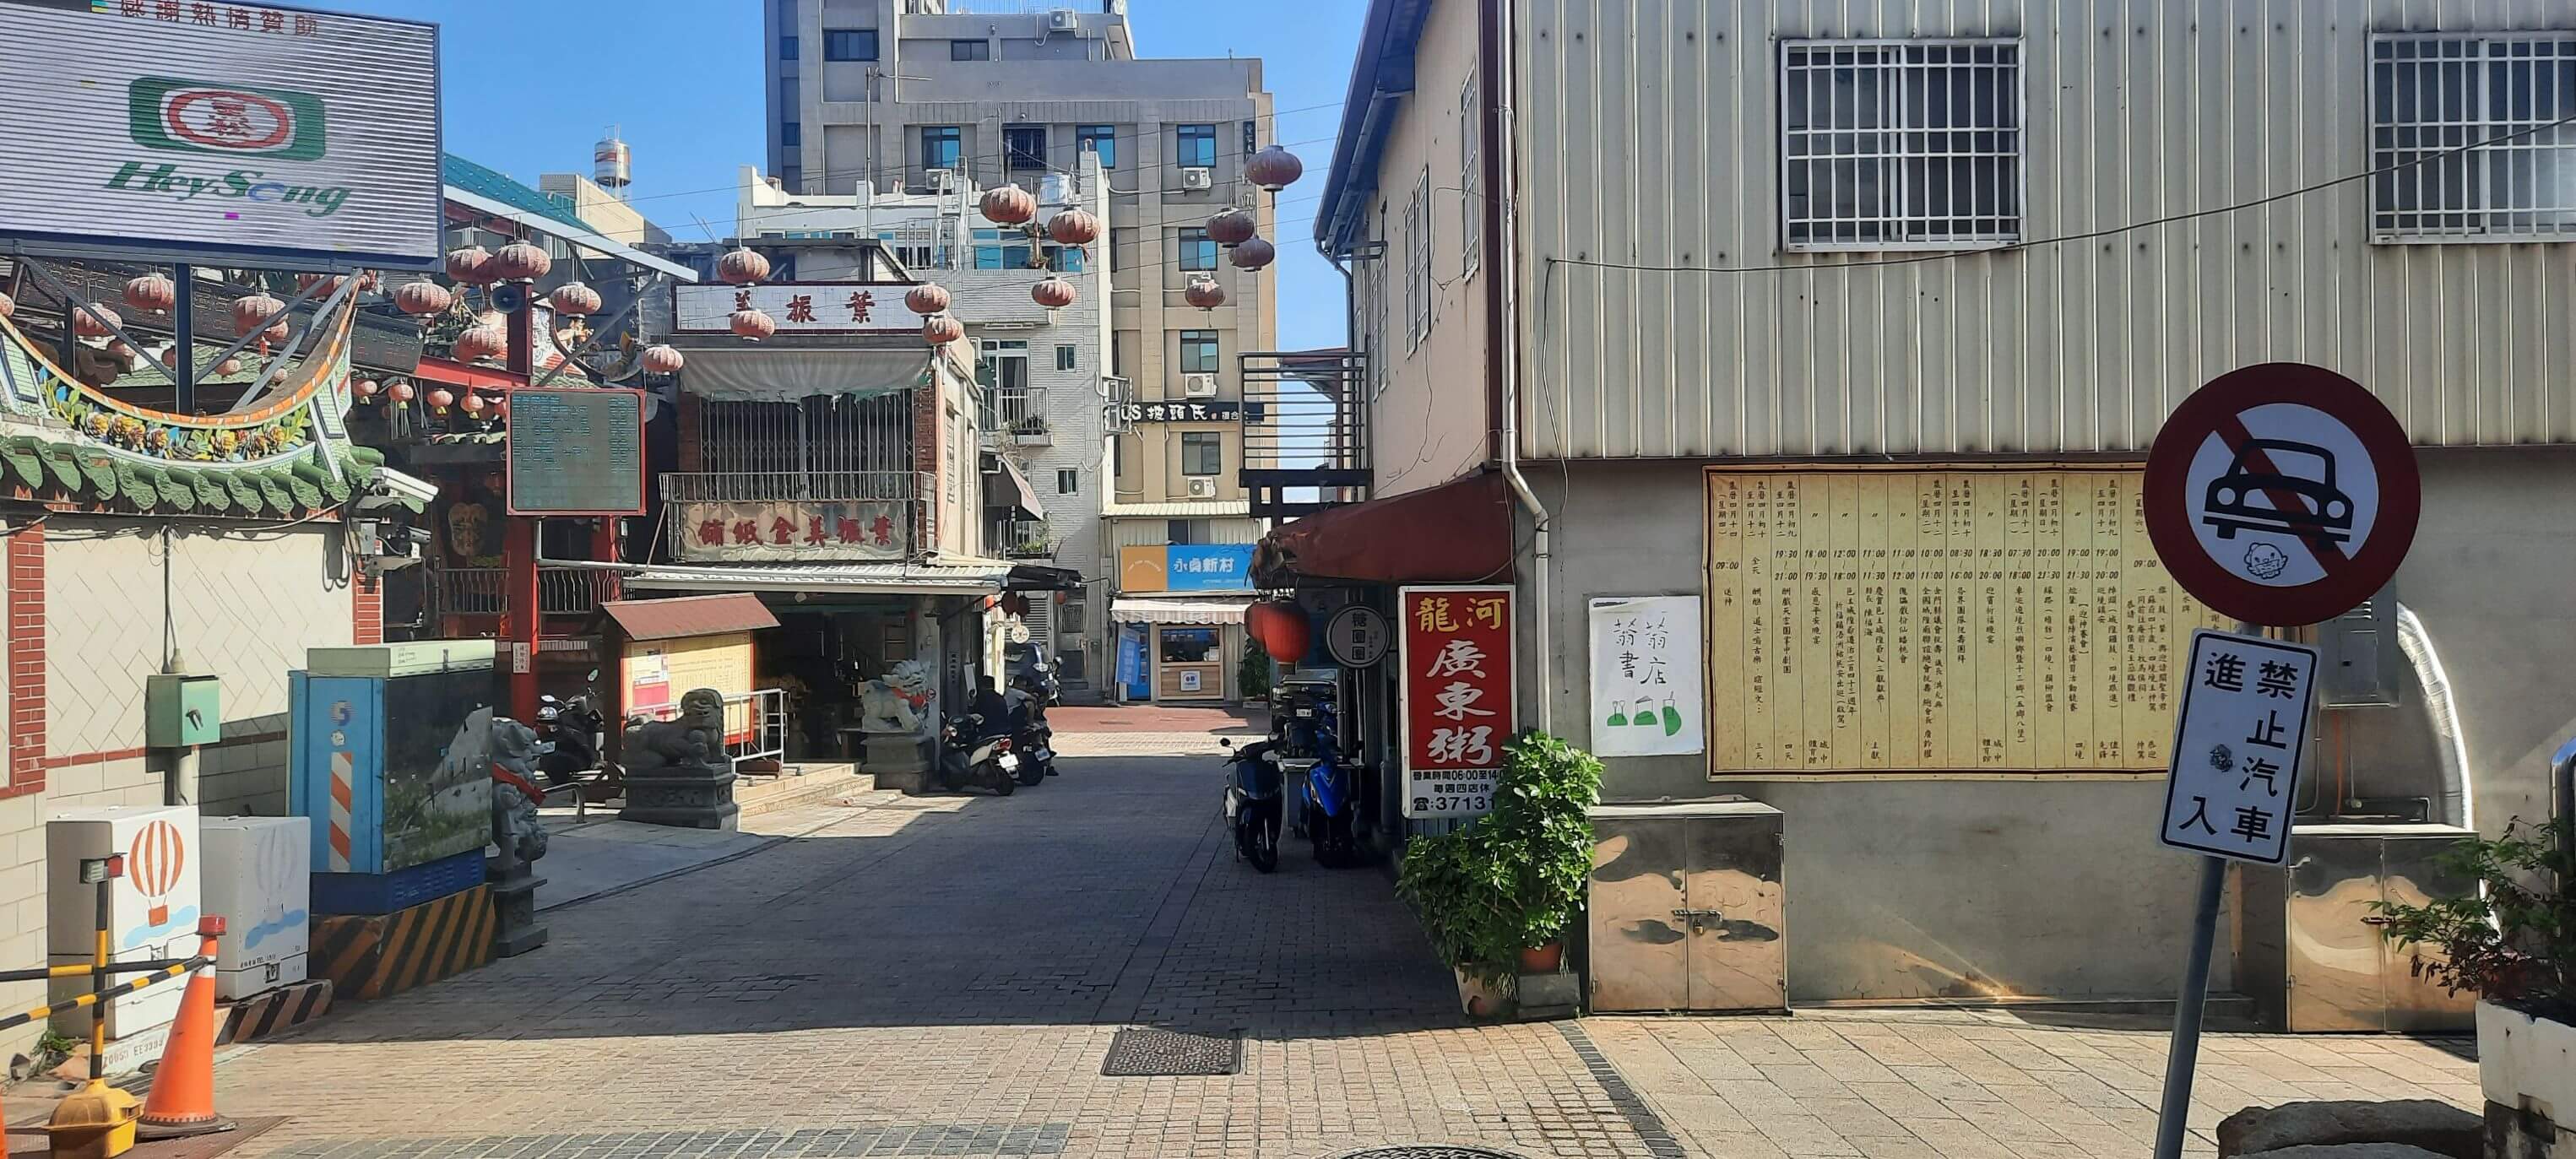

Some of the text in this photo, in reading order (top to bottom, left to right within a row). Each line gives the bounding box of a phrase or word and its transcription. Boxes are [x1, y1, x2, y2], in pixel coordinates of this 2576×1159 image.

[1775, 550, 1798, 558] 19:30
[1833, 550, 1857, 558] 12:00
[1863, 550, 1885, 558] 11:00
[1892, 550, 1915, 558] 11:00
[1920, 550, 1943, 558] 10:00
[1950, 549, 1972, 557] 08:30
[1979, 549, 2002, 557] 18:30
[2008, 549, 2031, 557] 07:30
[2038, 549, 2060, 557] 20:00
[2067, 549, 2090, 557] 19:00
[2096, 549, 2118, 557] 19:00
[1174, 558, 1234, 572] 永貞新村
[1716, 561, 1738, 570] 09:00
[1752, 556, 1761, 575] 全天
[2134, 560, 2156, 568] 09:00
[1775, 572, 1798, 581] 21:00
[1804, 572, 1827, 581] 19:30
[1834, 572, 1857, 581] 18:00
[1863, 572, 1885, 581] 11:30
[1892, 572, 1915, 581] 12:00
[1920, 572, 1943, 581] 11:00
[1950, 571, 1972, 580] 16:00
[1979, 571, 2002, 580] 20:00
[2009, 571, 2031, 580] 18:00
[2037, 571, 2060, 580] 21:30
[2067, 571, 2090, 580] 21:30
[2095, 571, 2118, 580] 20:00
[1415, 597, 1506, 633] 龍河
[1426, 640, 1496, 765] 廣東粥
[2179, 653, 2246, 836] 進入
[2231, 659, 2298, 843] 禁止汽車
[1434, 783, 1489, 793] 每週四店休
